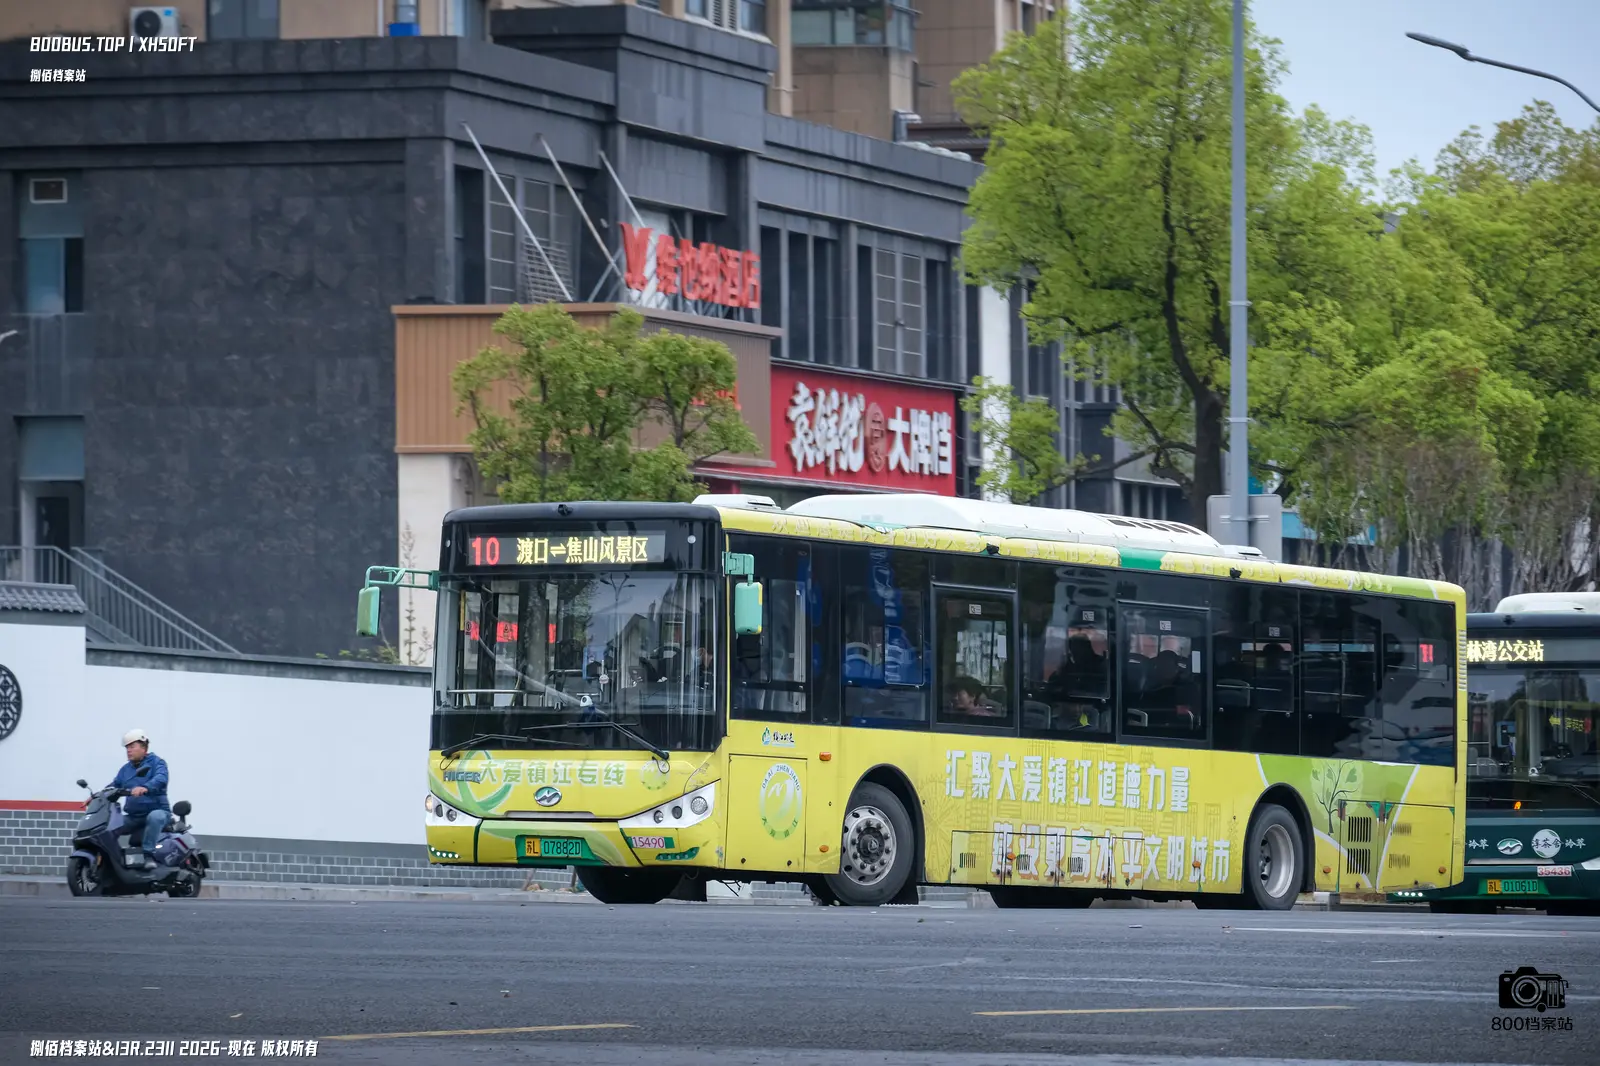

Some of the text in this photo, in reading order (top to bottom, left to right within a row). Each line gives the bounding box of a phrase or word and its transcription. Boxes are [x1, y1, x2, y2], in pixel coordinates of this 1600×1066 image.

[472, 536, 500, 566] 10
[480, 760, 626, 786] 大爱镇江专线
[945, 750, 1190, 812] 汇聚大爱镇江道德力量
[632, 836, 665, 849] 15490
[990, 821, 1231, 884] 建设更高水平文明城市
[1538, 866, 1571, 876] 35436
